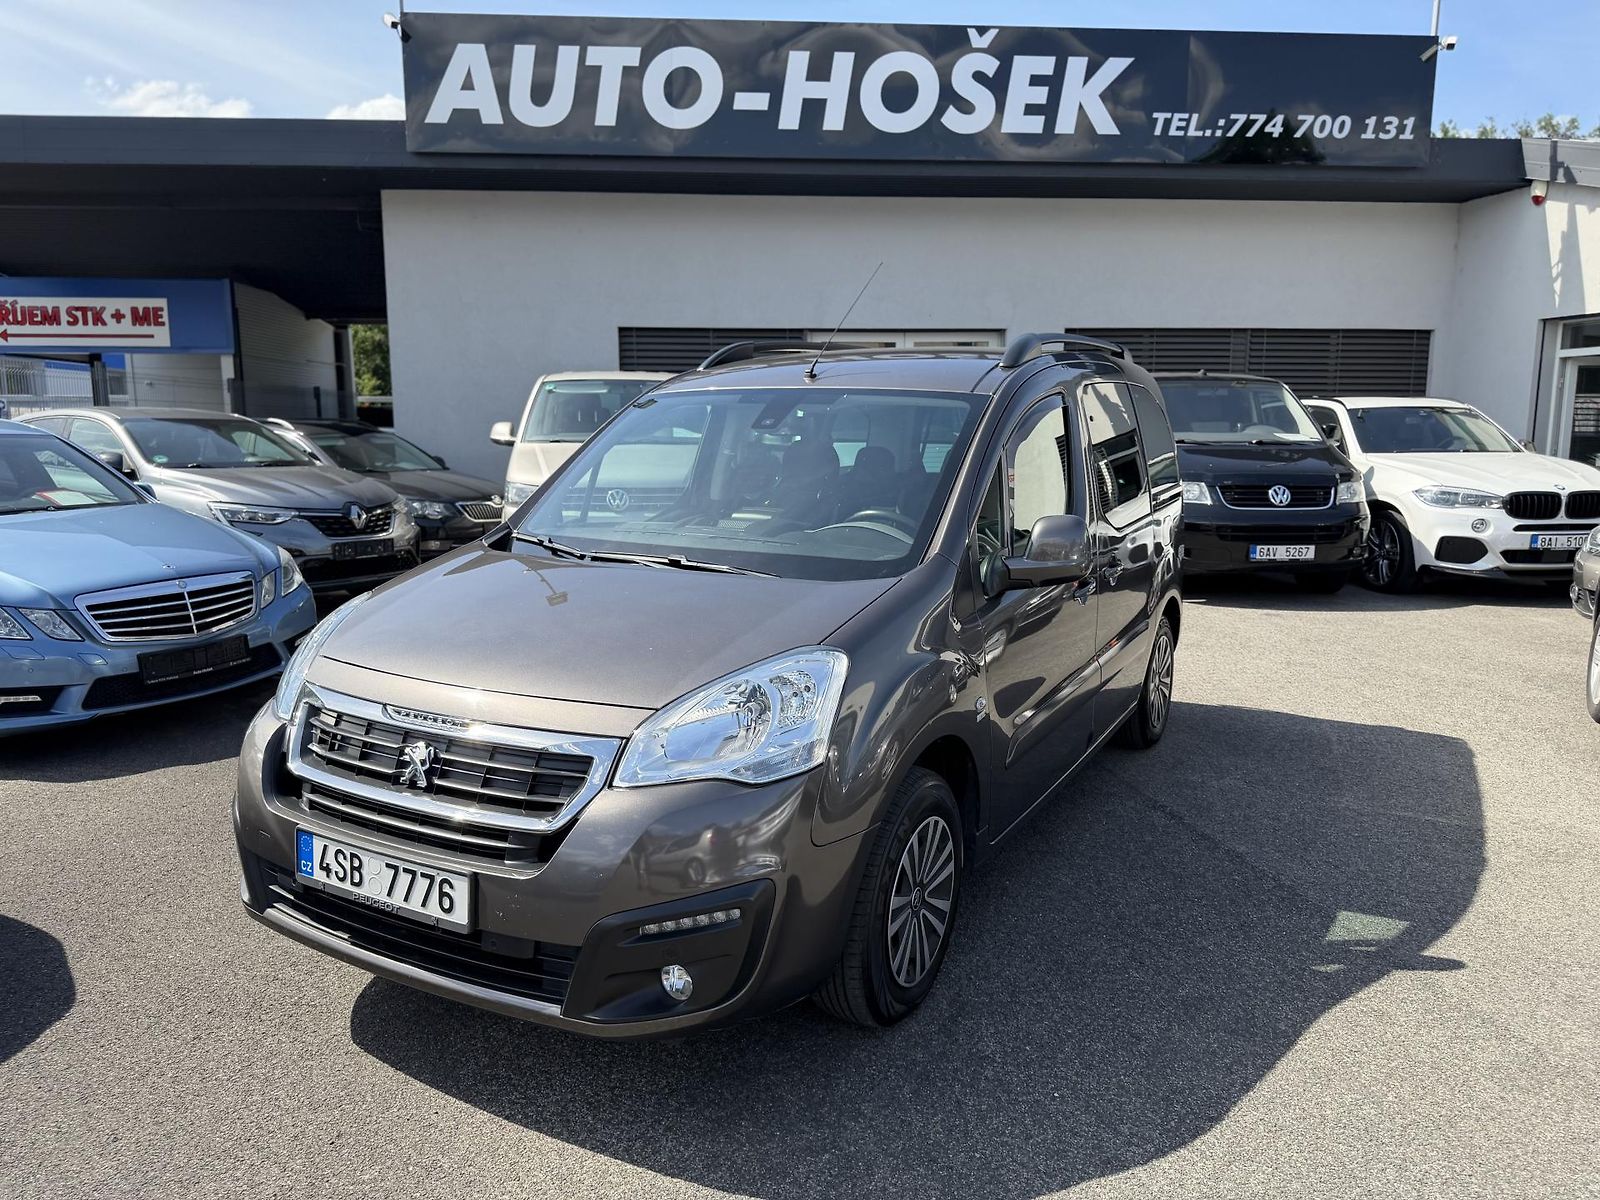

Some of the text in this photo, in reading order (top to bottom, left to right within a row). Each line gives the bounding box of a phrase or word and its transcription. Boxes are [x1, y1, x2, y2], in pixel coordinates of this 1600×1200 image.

[424, 27, 1135, 136] AUTO-HOŠEK
[1152, 112, 1416, 141] TEL.:774 700 131
[66, 306, 107, 327] STK
[130, 306, 166, 327] ME
[1258, 546, 1310, 558] 6AV 5267
[301, 859, 312, 873] CZ
[319, 843, 454, 914] 4SB 7776
[352, 892, 401, 915] PEUGEOT
